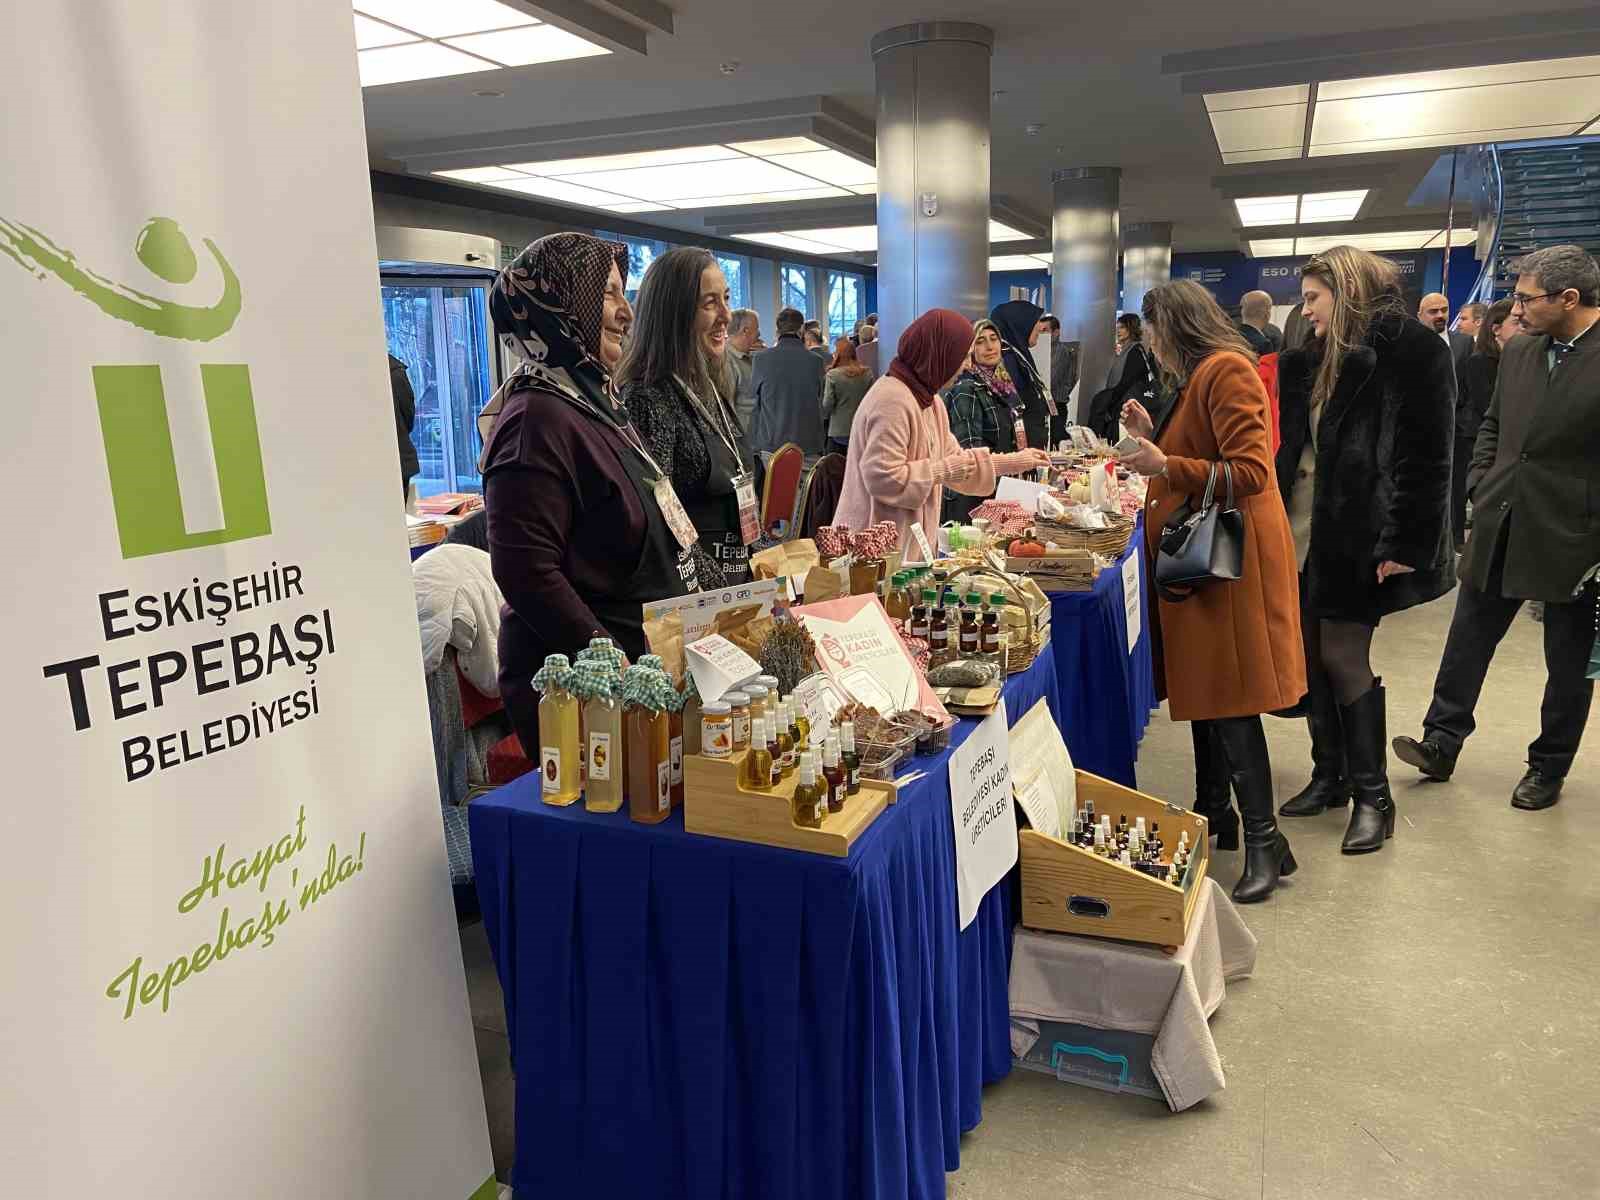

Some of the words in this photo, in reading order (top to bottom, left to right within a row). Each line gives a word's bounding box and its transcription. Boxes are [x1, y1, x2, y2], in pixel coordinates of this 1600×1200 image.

[98, 561, 305, 641] ESKİŞEHİR
[43, 608, 336, 732] TEPEBAŞI
[122, 679, 320, 783] BELEDİYESİ
[178, 804, 308, 914] Hayat
[106, 831, 367, 1020] Tepebaşı'nda!
